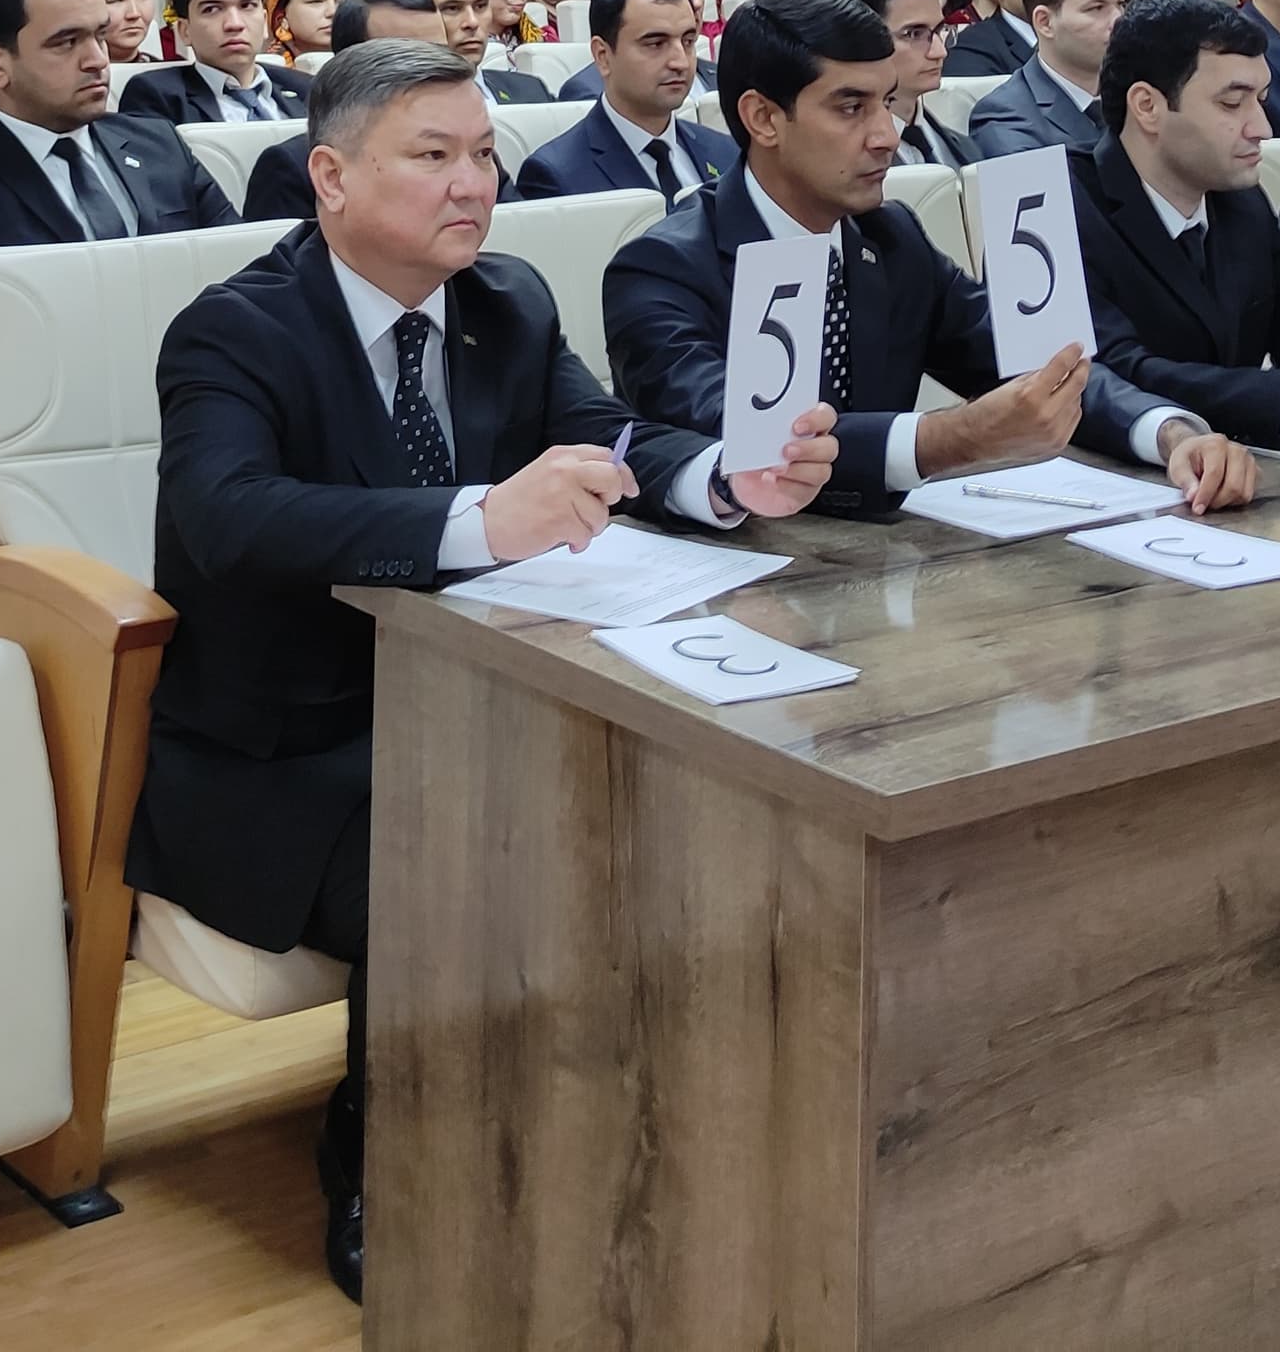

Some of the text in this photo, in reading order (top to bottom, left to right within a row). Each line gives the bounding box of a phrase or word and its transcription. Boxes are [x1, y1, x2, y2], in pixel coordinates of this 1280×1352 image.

[1010, 191, 1058, 316] 5
[750, 281, 803, 411] 5
[1143, 537, 1250, 568] 3
[671, 632, 781, 676] 3
